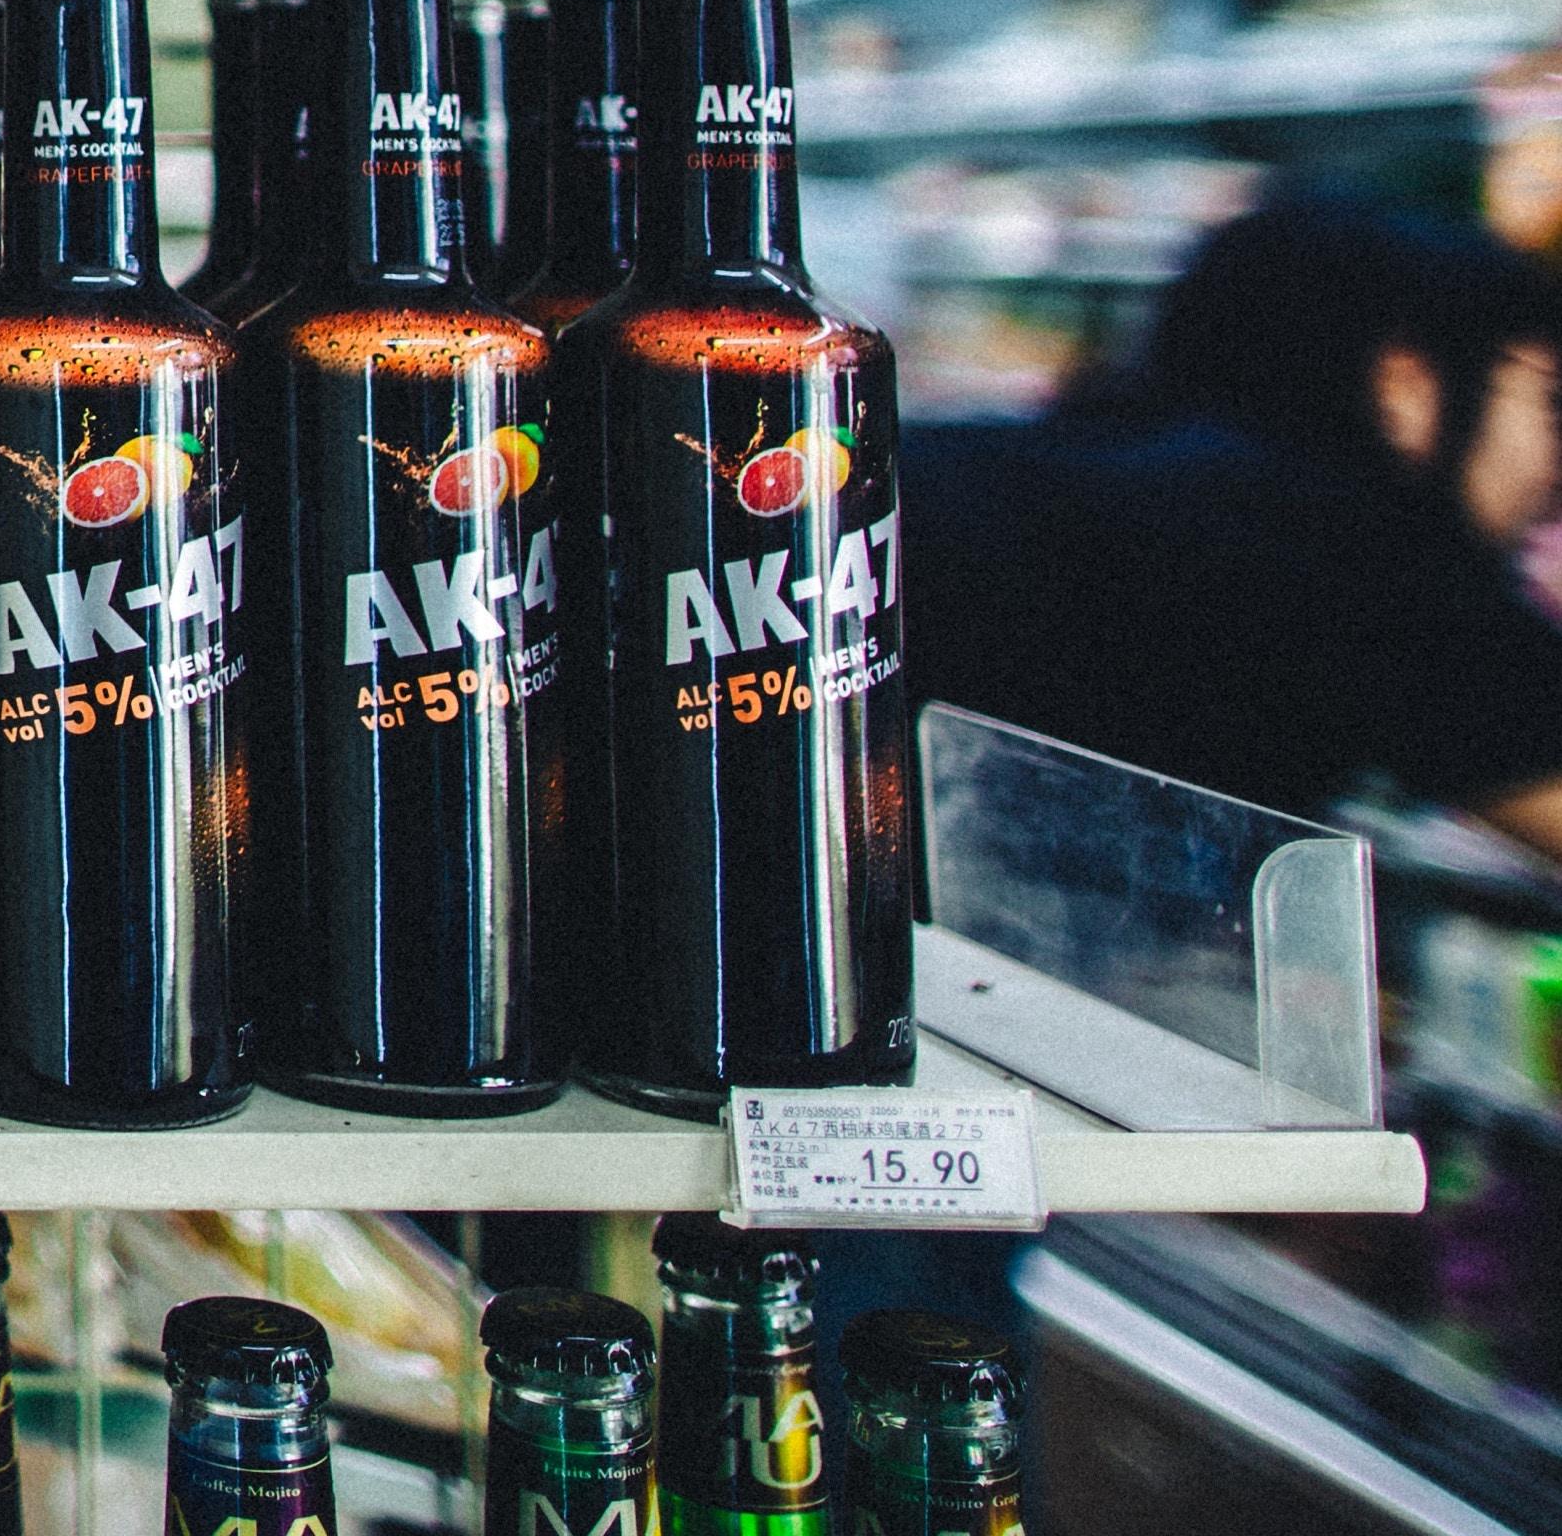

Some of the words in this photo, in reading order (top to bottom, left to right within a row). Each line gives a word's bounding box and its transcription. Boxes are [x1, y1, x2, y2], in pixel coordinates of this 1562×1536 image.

[32, 96, 145, 138] AK-47
[695, 83, 794, 125] AK-47
[34, 144, 77, 159] MEN'S
[80, 142, 145, 158] COCKTAIL
[370, 137, 418, 152] MEN'S
[696, 130, 743, 144] MEN'S
[344, 517, 561, 667] AK-4
[665, 509, 900, 667] AK-47
[163, 641, 226, 685] MEN'S
[817, 634, 879, 674] MEN'S
[166, 652, 247, 711] COCKTAIL
[417, 663, 511, 725] 5%
[676, 680, 724, 709] ALC
[726, 664, 813, 725] 5%
[822, 649, 902, 703] COCKTAIL
[0, 691, 52, 722] ALC
[55, 674, 155, 736] 5%
[356, 681, 413, 709] ALC
[2, 717, 45, 744] vol
[360, 705, 407, 732] vol
[679, 704, 716, 732] vol
[861, 1148, 981, 1185] 15.90
[247, 1481, 301, 1502] Mojito
[596, 1465, 644, 1481] Mojito
